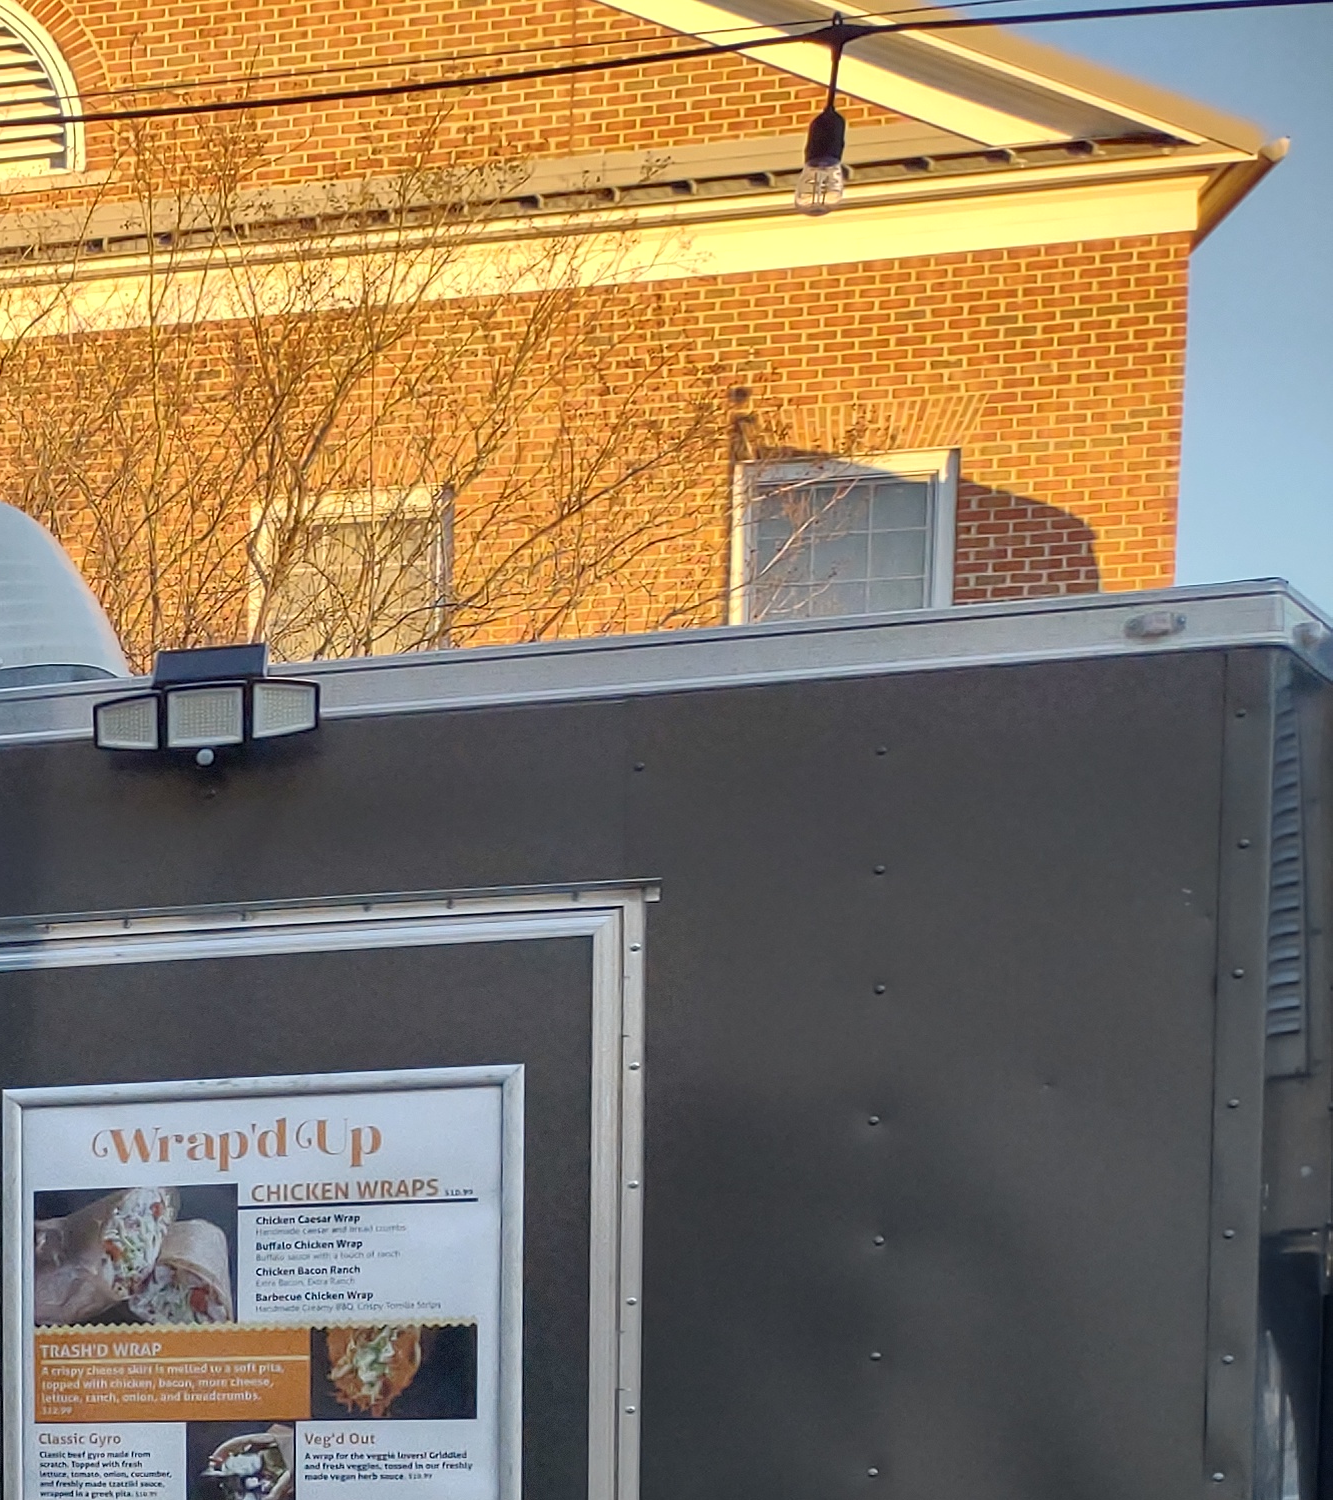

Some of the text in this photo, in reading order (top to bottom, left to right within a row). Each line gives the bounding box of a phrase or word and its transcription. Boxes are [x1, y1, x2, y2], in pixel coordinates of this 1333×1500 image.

[92, 1118, 381, 1171] Wrap'd Up
[251, 1183, 349, 1201] CHICKEN
[356, 1179, 439, 1198] WRAPS
[256, 1214, 360, 1225] Chicken Caesar Wrap
[256, 1240, 363, 1250] Buffalo Chicken Wrap
[256, 1266, 360, 1276] Chicken Bacon Ranch
[256, 1291, 373, 1301] Barbecue Chicken Wrap
[41, 1343, 162, 1358] TRASH'D WRAP
[52, 1366, 83, 1378] crispy
[86, 1366, 124, 1374] cheese
[128, 1365, 151, 1374] skirt
[168, 1365, 206, 1374] melted
[234, 1364, 256, 1373] soft
[42, 1379, 80, 1391] topped
[84, 1379, 107, 1388] with
[111, 1378, 155, 1389] chicken,
[159, 1378, 195, 1389] bacon,
[231, 1377, 274, 1388] cheese,
[39, 1433, 121, 1448] Classic Gyro
[305, 1433, 375, 1448] Veg'd Out
[367, 1453, 395, 1461] veggie
[72, 1461, 99, 1469] Topped
[442, 1463, 473, 1471] freshly
